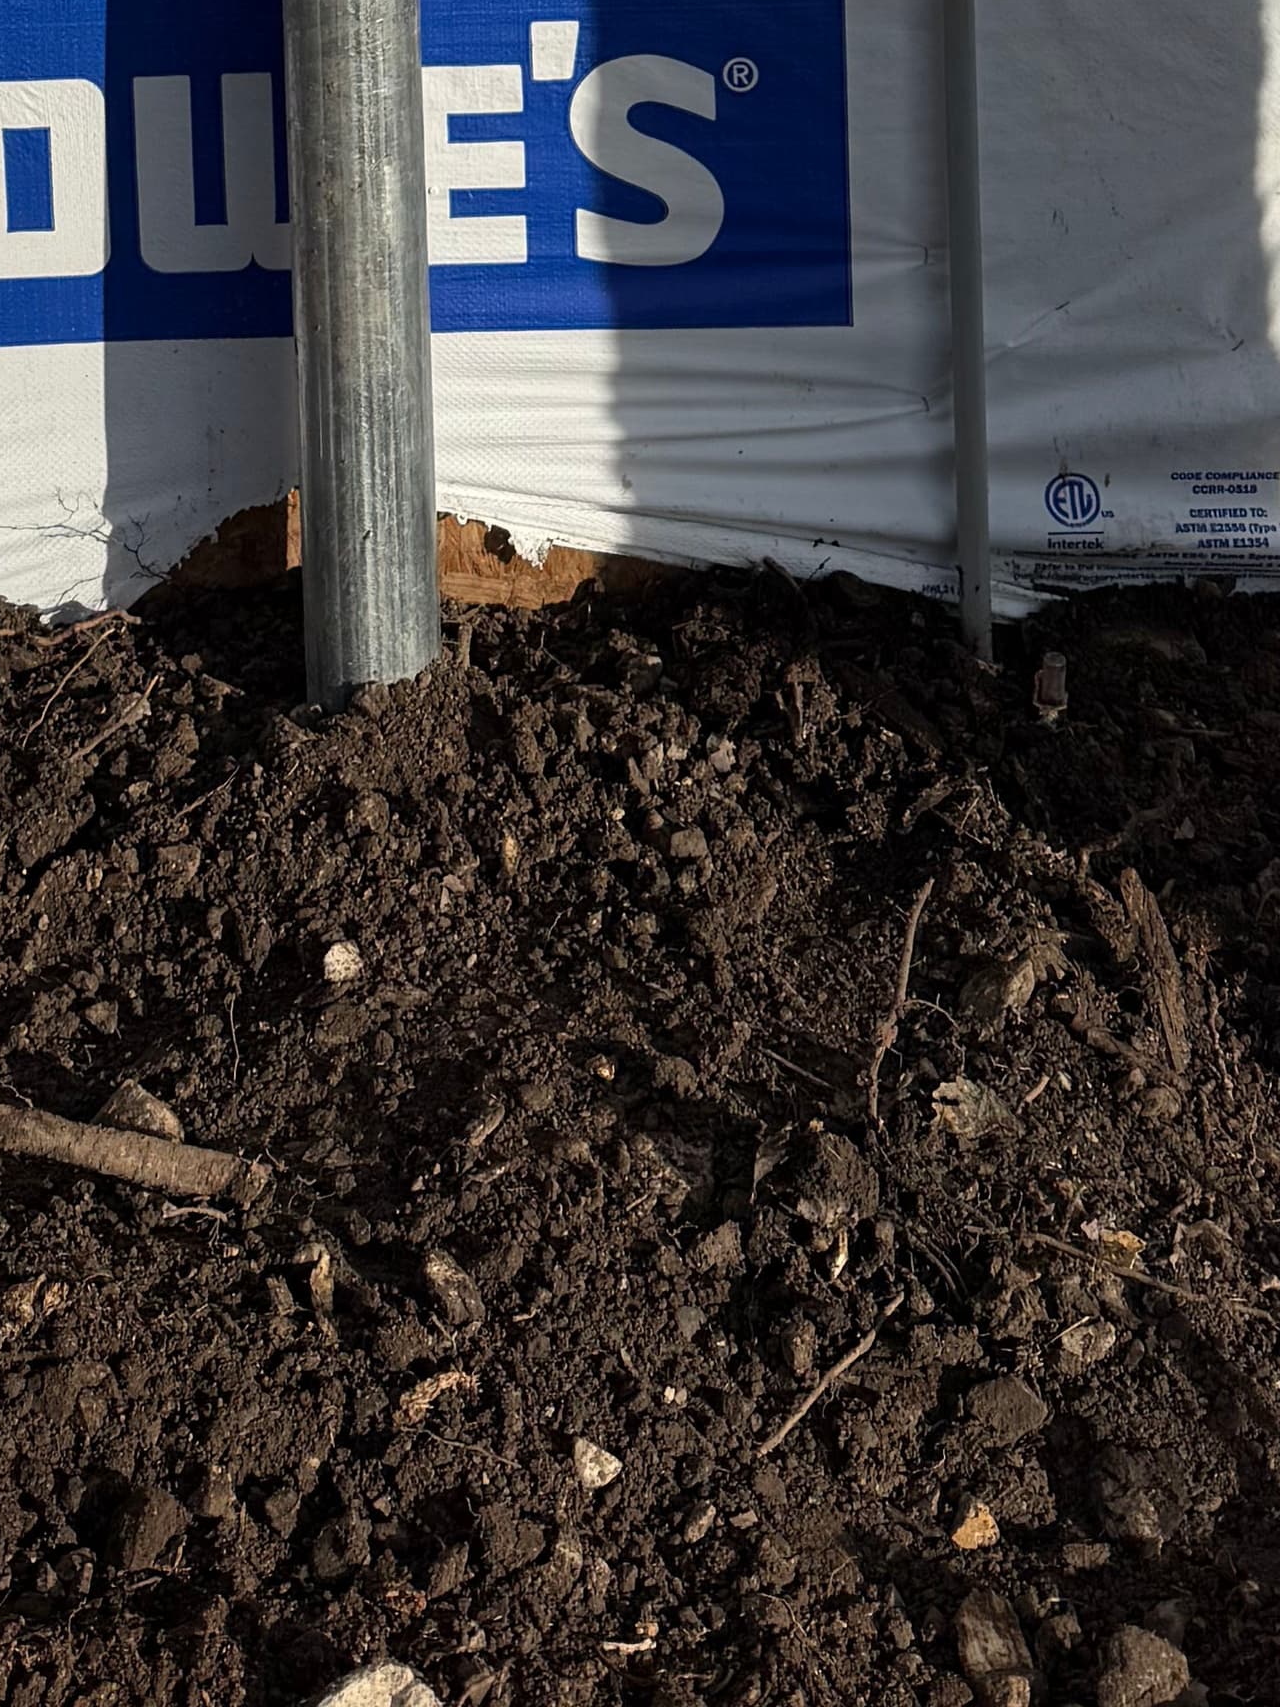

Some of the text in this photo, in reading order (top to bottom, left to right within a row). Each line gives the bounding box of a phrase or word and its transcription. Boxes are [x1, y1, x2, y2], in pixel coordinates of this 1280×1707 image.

[1170, 472, 1280, 481] CODE COMPLIANCE
[1189, 508, 1248, 518] CERTIFIED
[1047, 538, 1105, 550] Intertek
[1197, 538, 1230, 548] ASTM
